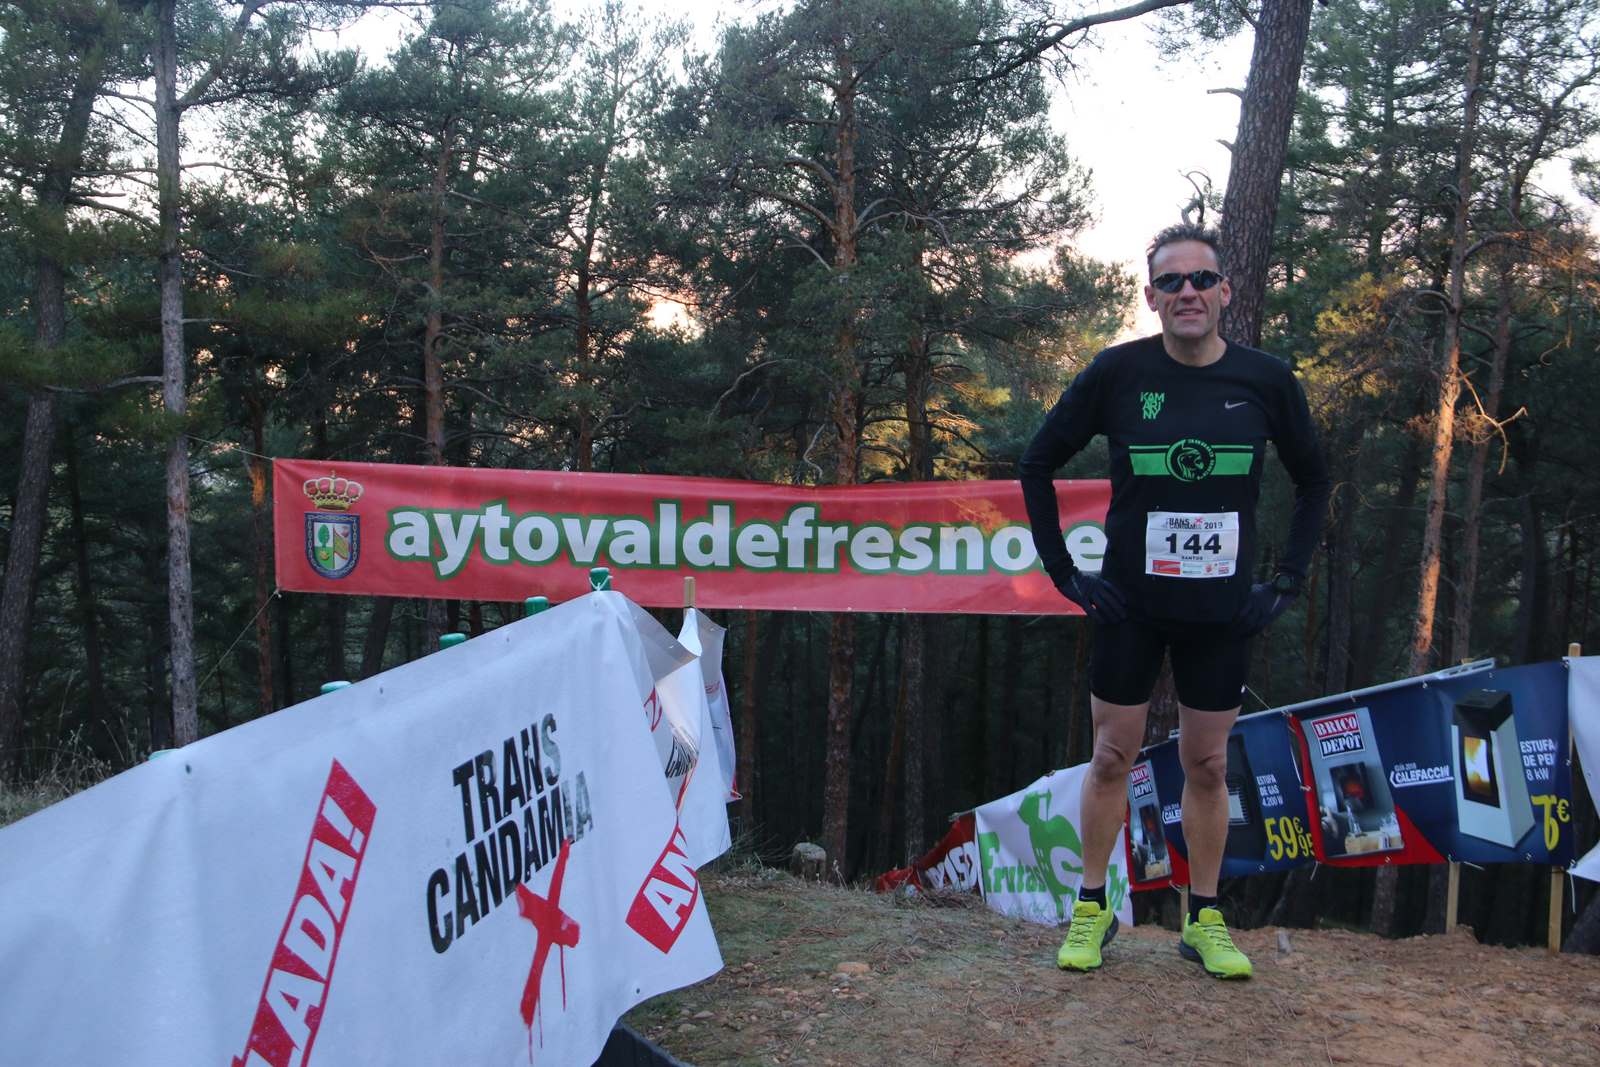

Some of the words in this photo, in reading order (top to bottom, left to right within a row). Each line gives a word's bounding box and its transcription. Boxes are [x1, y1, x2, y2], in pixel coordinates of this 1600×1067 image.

[1165, 533, 1222, 554] 144
[1312, 715, 1359, 737] BRICO
[1523, 754, 1537, 767] DE
[451, 712, 562, 844] TRANS
[426, 770, 594, 955] CANDAMIA
[245, 794, 365, 1067] ADA!
